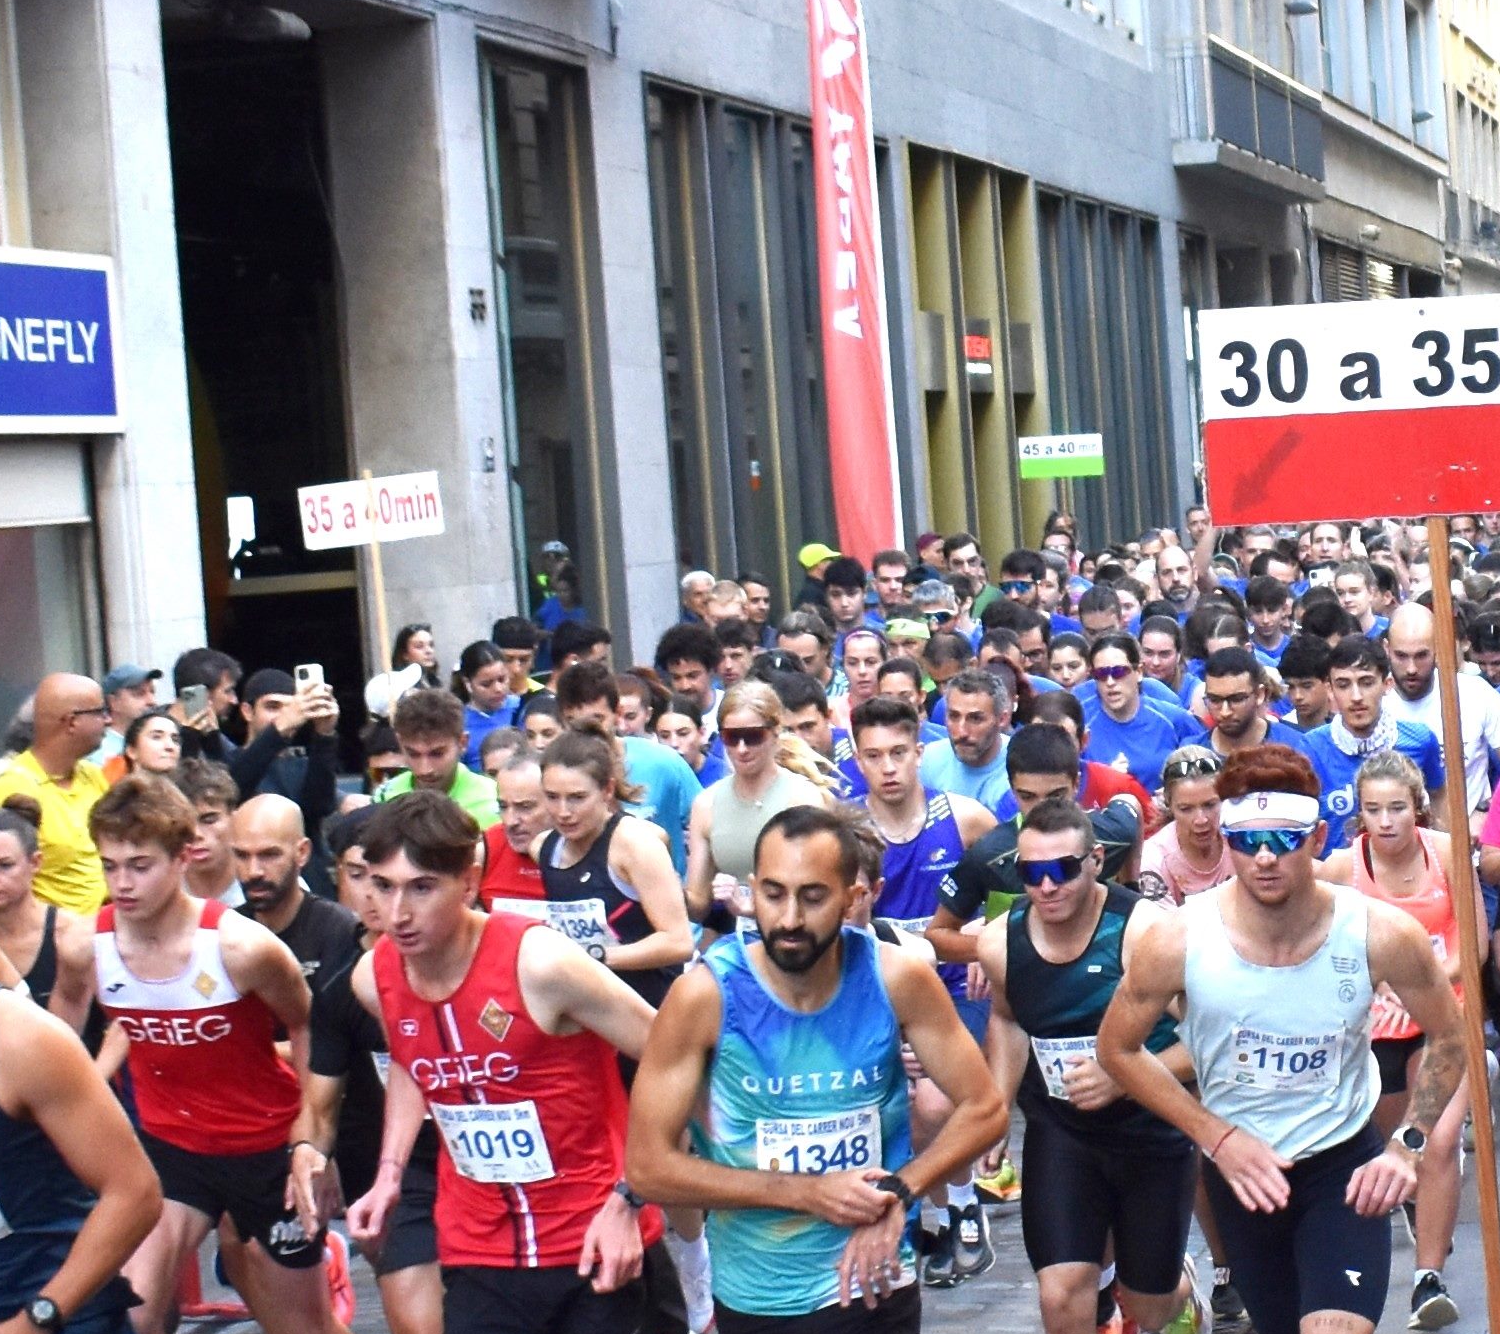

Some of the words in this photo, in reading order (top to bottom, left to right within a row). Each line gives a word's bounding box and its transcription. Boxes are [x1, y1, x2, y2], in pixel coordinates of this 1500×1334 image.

[1218, 338, 1308, 408] 30
[1339, 352, 1382, 401] a
[1023, 443, 1040, 455] 45
[1045, 445, 1053, 455] a
[1058, 442, 1075, 453] 40
[304, 495, 333, 533] 35
[343, 502, 357, 529] a
[1252, 1046, 1328, 1074] 1108
[740, 1065, 885, 1095] QUETZAL
[458, 1129, 535, 1159] 1019
[784, 1134, 870, 1176] 1348
